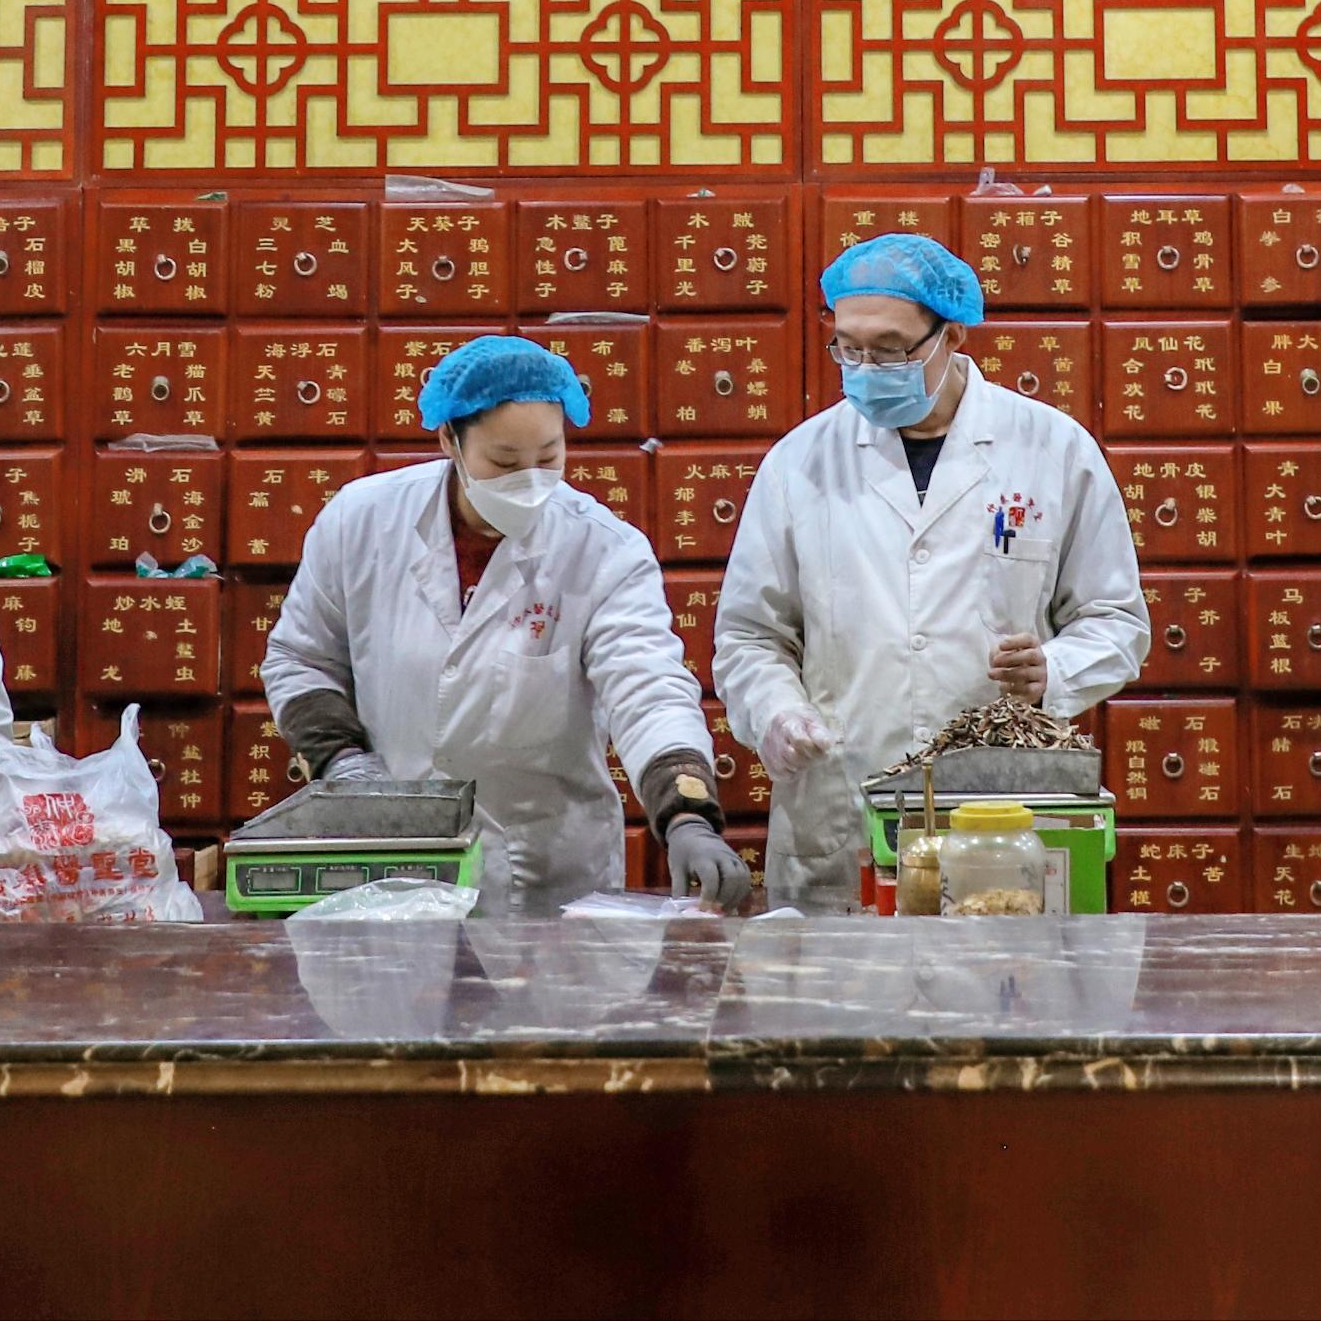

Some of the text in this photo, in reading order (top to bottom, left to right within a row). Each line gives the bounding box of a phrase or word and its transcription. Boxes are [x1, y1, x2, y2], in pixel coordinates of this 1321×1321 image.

[271, 216, 336, 231] 灵芝
[407, 216, 479, 231] 天葵子
[688, 213, 754, 228] 木贼
[853, 211, 919, 226] 重楼
[1131, 210, 1203, 224] 地耳草
[24, 238, 45, 298] 石榴皮
[114, 239, 136, 299] 黑胡椒
[185, 239, 206, 300] 白胡椒
[255, 238, 277, 298] 三七粉
[395, 238, 418, 300] 大风子
[468, 238, 489, 299] 鸦胆子
[535, 237, 556, 297] 急性子
[675, 235, 696, 296] 千里光
[1051, 233, 1072, 294] 谷精草
[1121, 232, 1142, 292] 积雪草
[1193, 231, 1214, 292] 鸡骨草
[125, 342, 196, 357] 六月雪
[265, 343, 337, 358] 海浮石
[685, 337, 757, 352] 番泻叶
[1132, 336, 1204, 351] 凤仙花
[22, 364, 44, 425] 垂盆草
[184, 365, 206, 425] 猫爪草
[254, 365, 275, 425] 天竺黄
[394, 363, 416, 424] 煅龙骨
[747, 358, 768, 419] 桑螵蛸
[1123, 358, 1144, 420] 合欢花
[1263, 359, 1283, 415] 白果
[125, 468, 192, 483] 滑石
[686, 465, 756, 478] 火麻仁
[1134, 463, 1206, 478] 地骨皮
[182, 491, 204, 552] 海金沙
[674, 487, 696, 548] 郁李仁
[1196, 485, 1217, 546] 银柴胡
[1265, 484, 1287, 544] 大青叶
[114, 596, 186, 611] 炒水蛭
[1269, 611, 1291, 673] 板蓝根
[1139, 716, 1205, 730] 磁石
[180, 745, 202, 808] 盐杜仲
[1199, 738, 1220, 800] 煅磁石
[1140, 844, 1214, 859] 蛇床子
